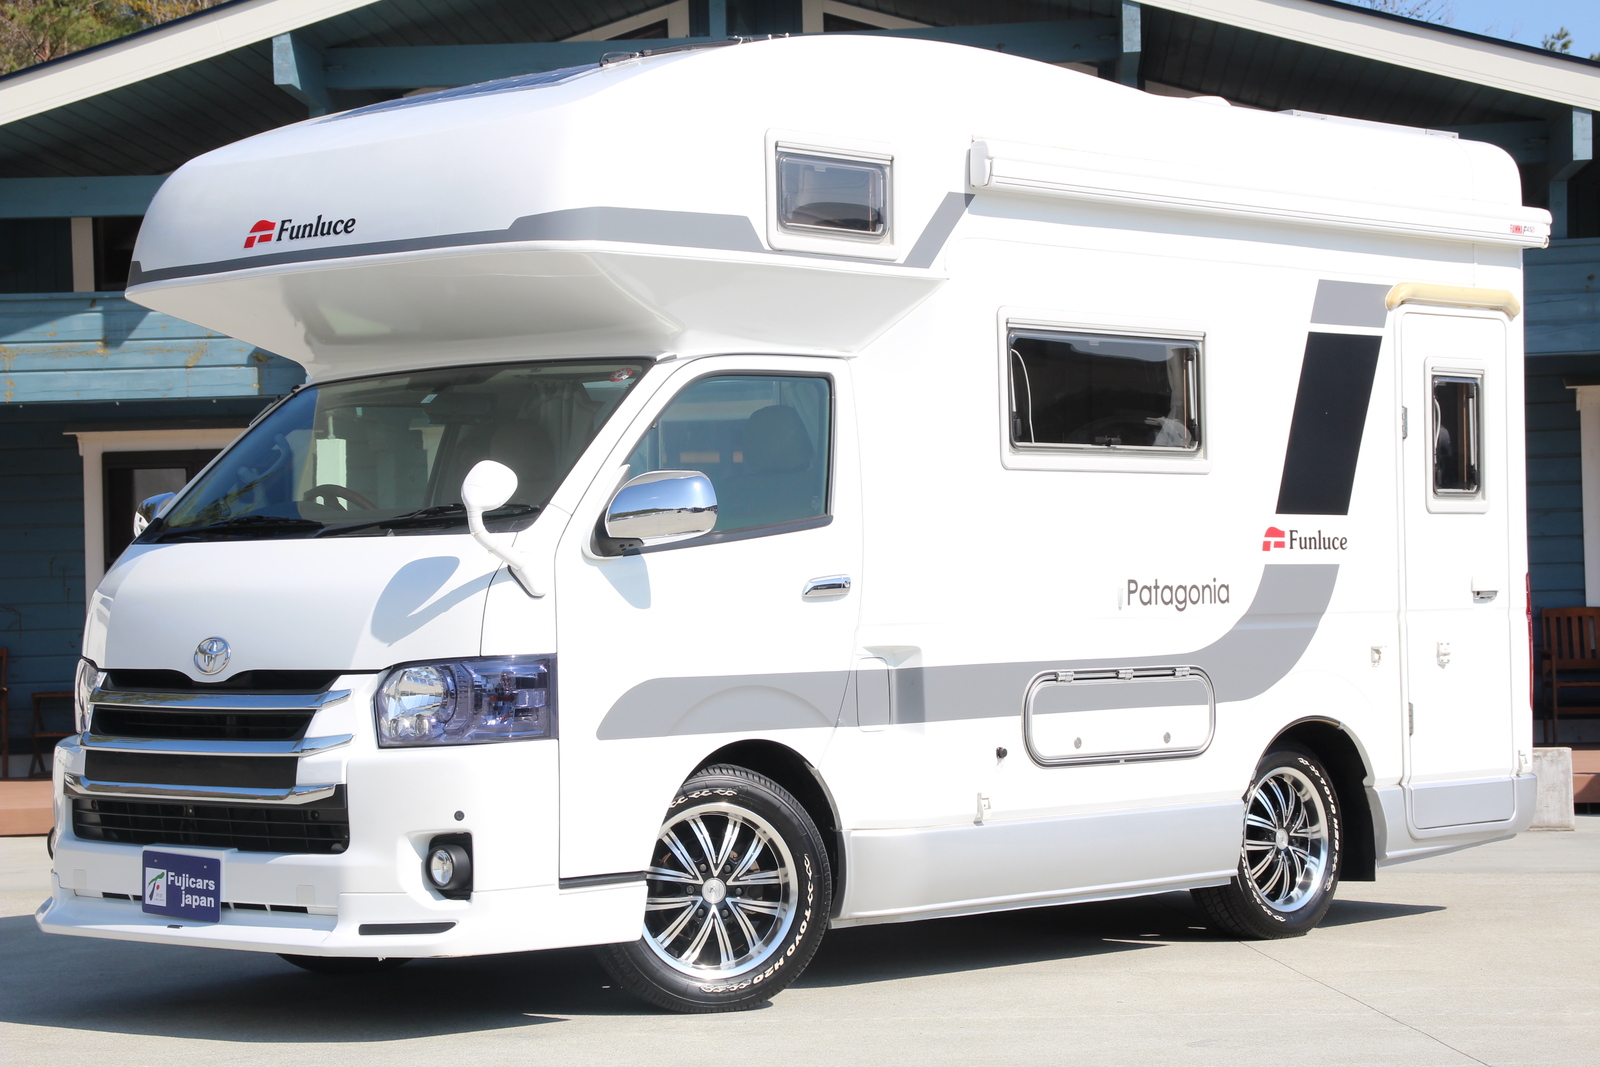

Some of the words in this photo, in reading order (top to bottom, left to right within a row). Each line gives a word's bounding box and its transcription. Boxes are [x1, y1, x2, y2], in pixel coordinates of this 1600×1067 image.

[276, 214, 356, 242] Funluce
[1289, 529, 1348, 550] Funluce
[1127, 577, 1230, 612] Patagonia
[1320, 778, 1337, 815] TOYO
[168, 871, 216, 891] Fujicars
[181, 890, 215, 909] japan
[786, 909, 812, 957] TOYO
